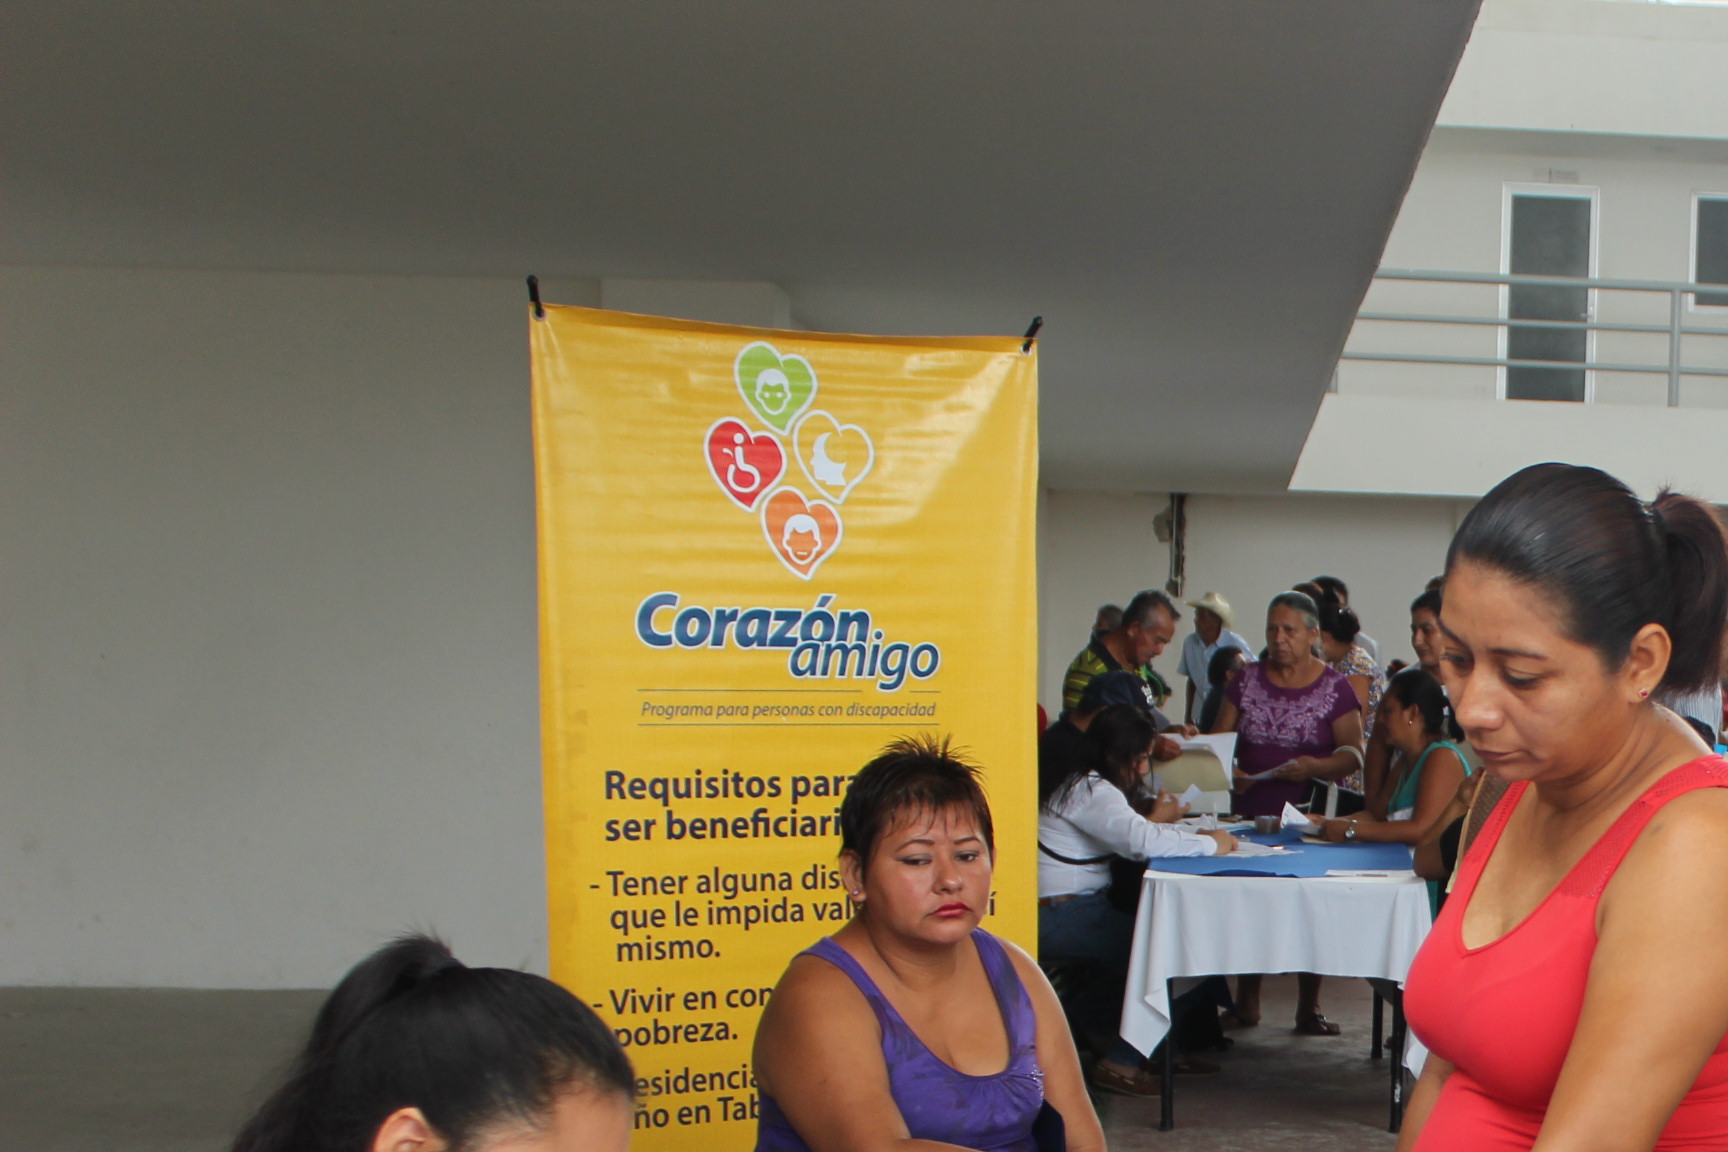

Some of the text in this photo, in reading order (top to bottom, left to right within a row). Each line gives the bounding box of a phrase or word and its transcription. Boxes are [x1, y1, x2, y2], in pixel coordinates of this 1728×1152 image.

[636, 593, 870, 648] Corazón
[789, 631, 940, 690] amigo
[641, 702, 936, 720] Programa para personas con discapacidad
[605, 769, 856, 806] Requisitos par
[605, 807, 841, 841] ser beneficiari
[606, 870, 688, 896] Tener
[696, 867, 792, 899] alguna
[610, 908, 665, 936] que
[675, 901, 698, 926] le
[706, 897, 804, 930] impida
[617, 936, 720, 962] mismo.
[609, 987, 675, 1015] Vivir
[683, 991, 717, 1010] en
[613, 1018, 738, 1048] pobreza.
[678, 1104, 711, 1125] en
